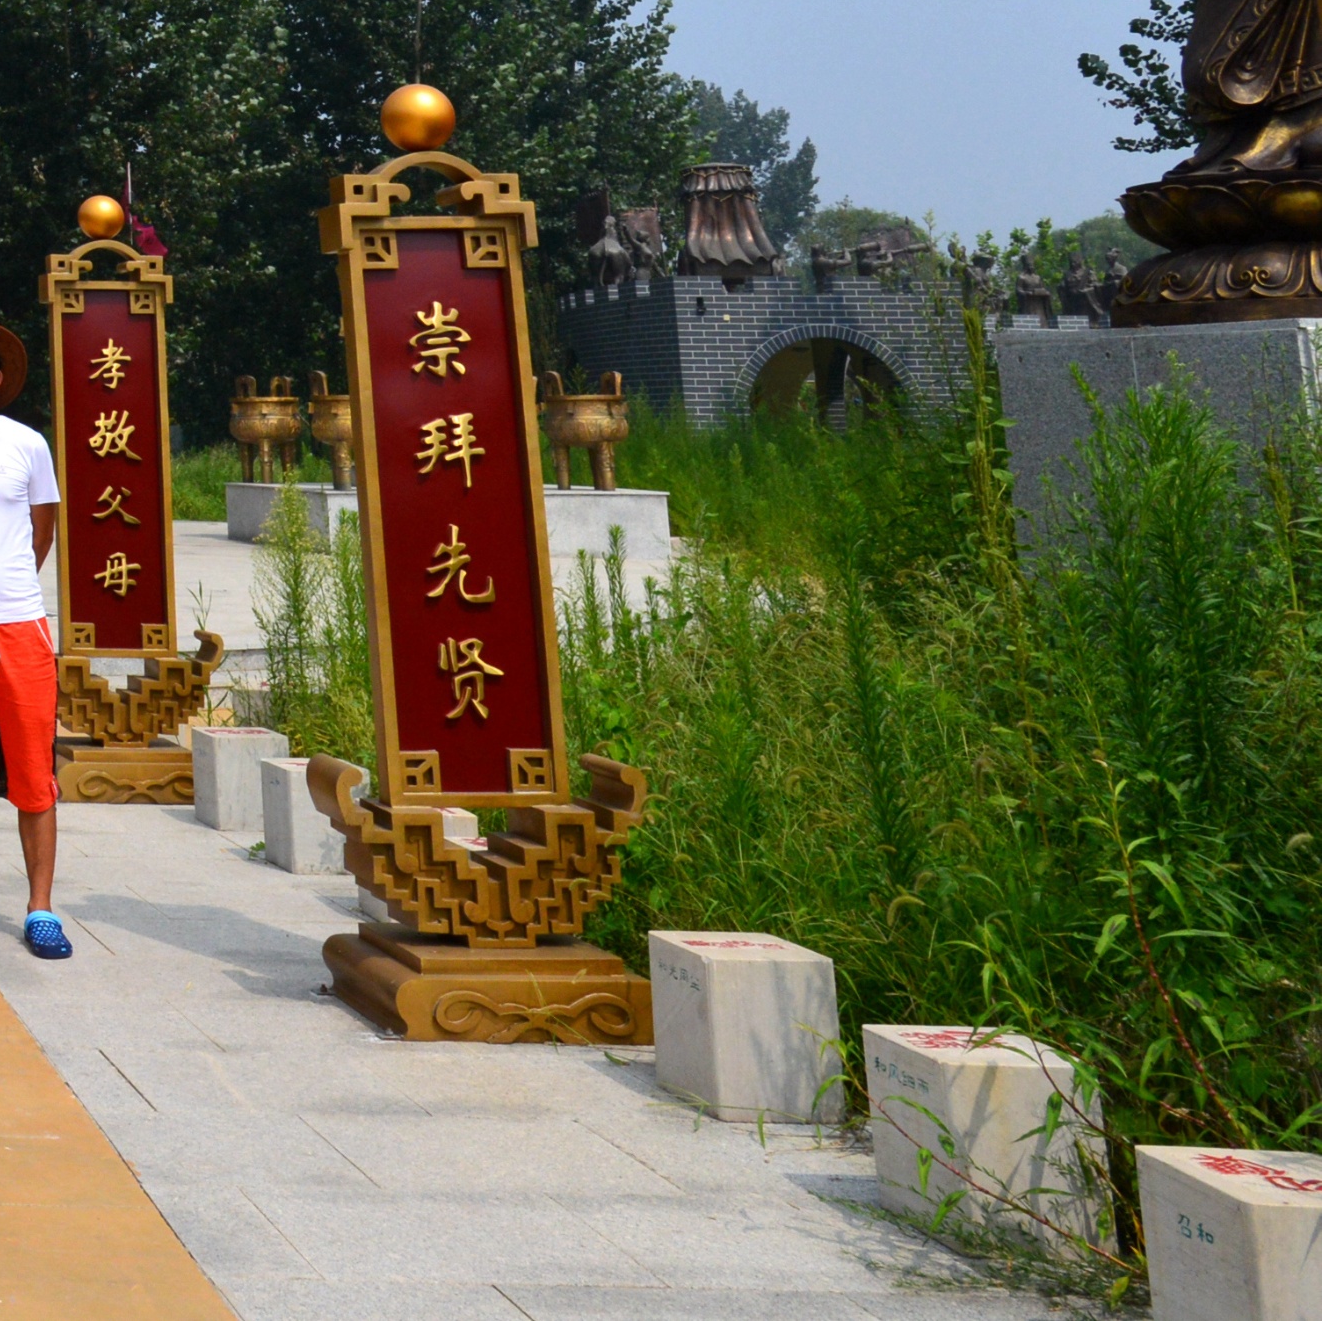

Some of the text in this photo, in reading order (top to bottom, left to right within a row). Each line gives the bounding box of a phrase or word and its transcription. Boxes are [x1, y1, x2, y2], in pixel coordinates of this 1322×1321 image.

[89, 338, 142, 598] 孝敬父母
[409, 300, 504, 720] 崇拜先贤
